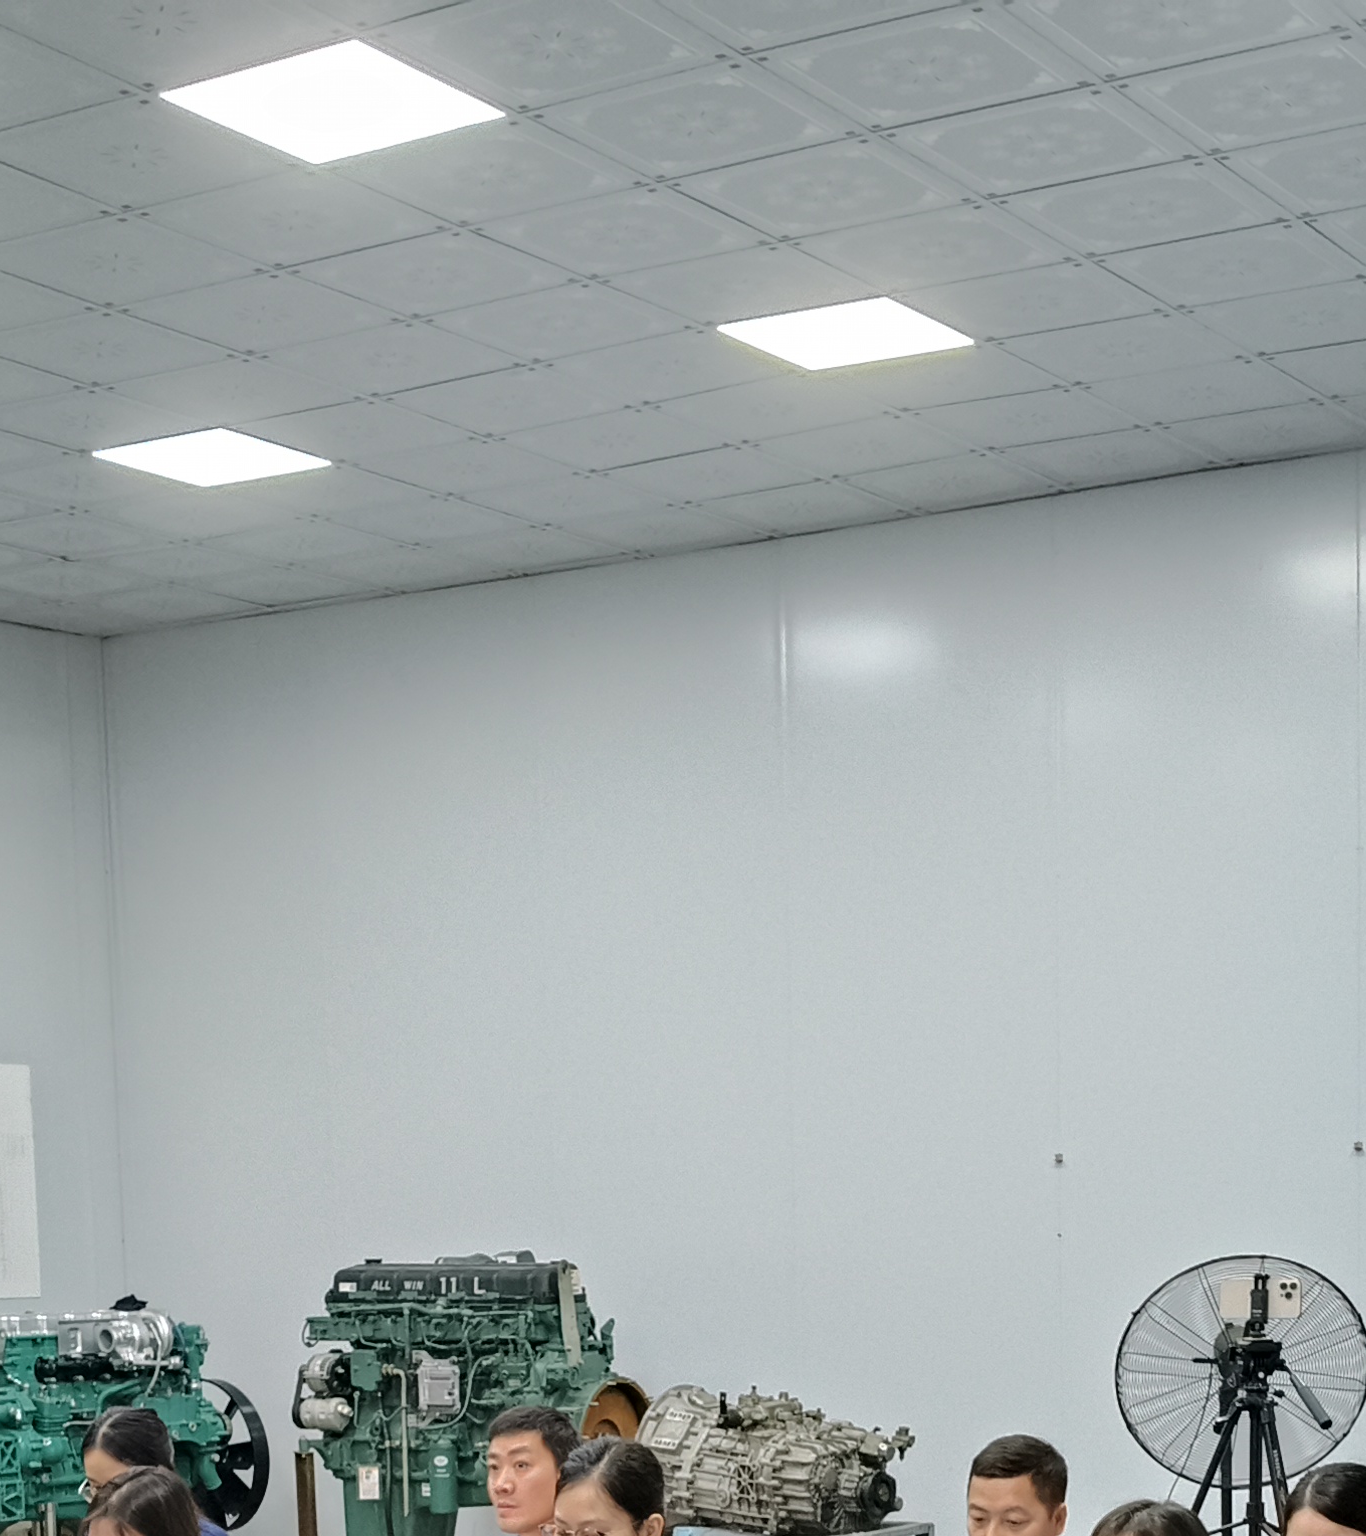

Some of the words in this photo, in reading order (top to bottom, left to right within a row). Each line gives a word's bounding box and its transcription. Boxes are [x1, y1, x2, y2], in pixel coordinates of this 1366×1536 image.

[371, 1280, 391, 1291] ALL
[403, 1281, 424, 1290] WIN
[439, 1276, 457, 1295] 11
[473, 1276, 487, 1295] L
